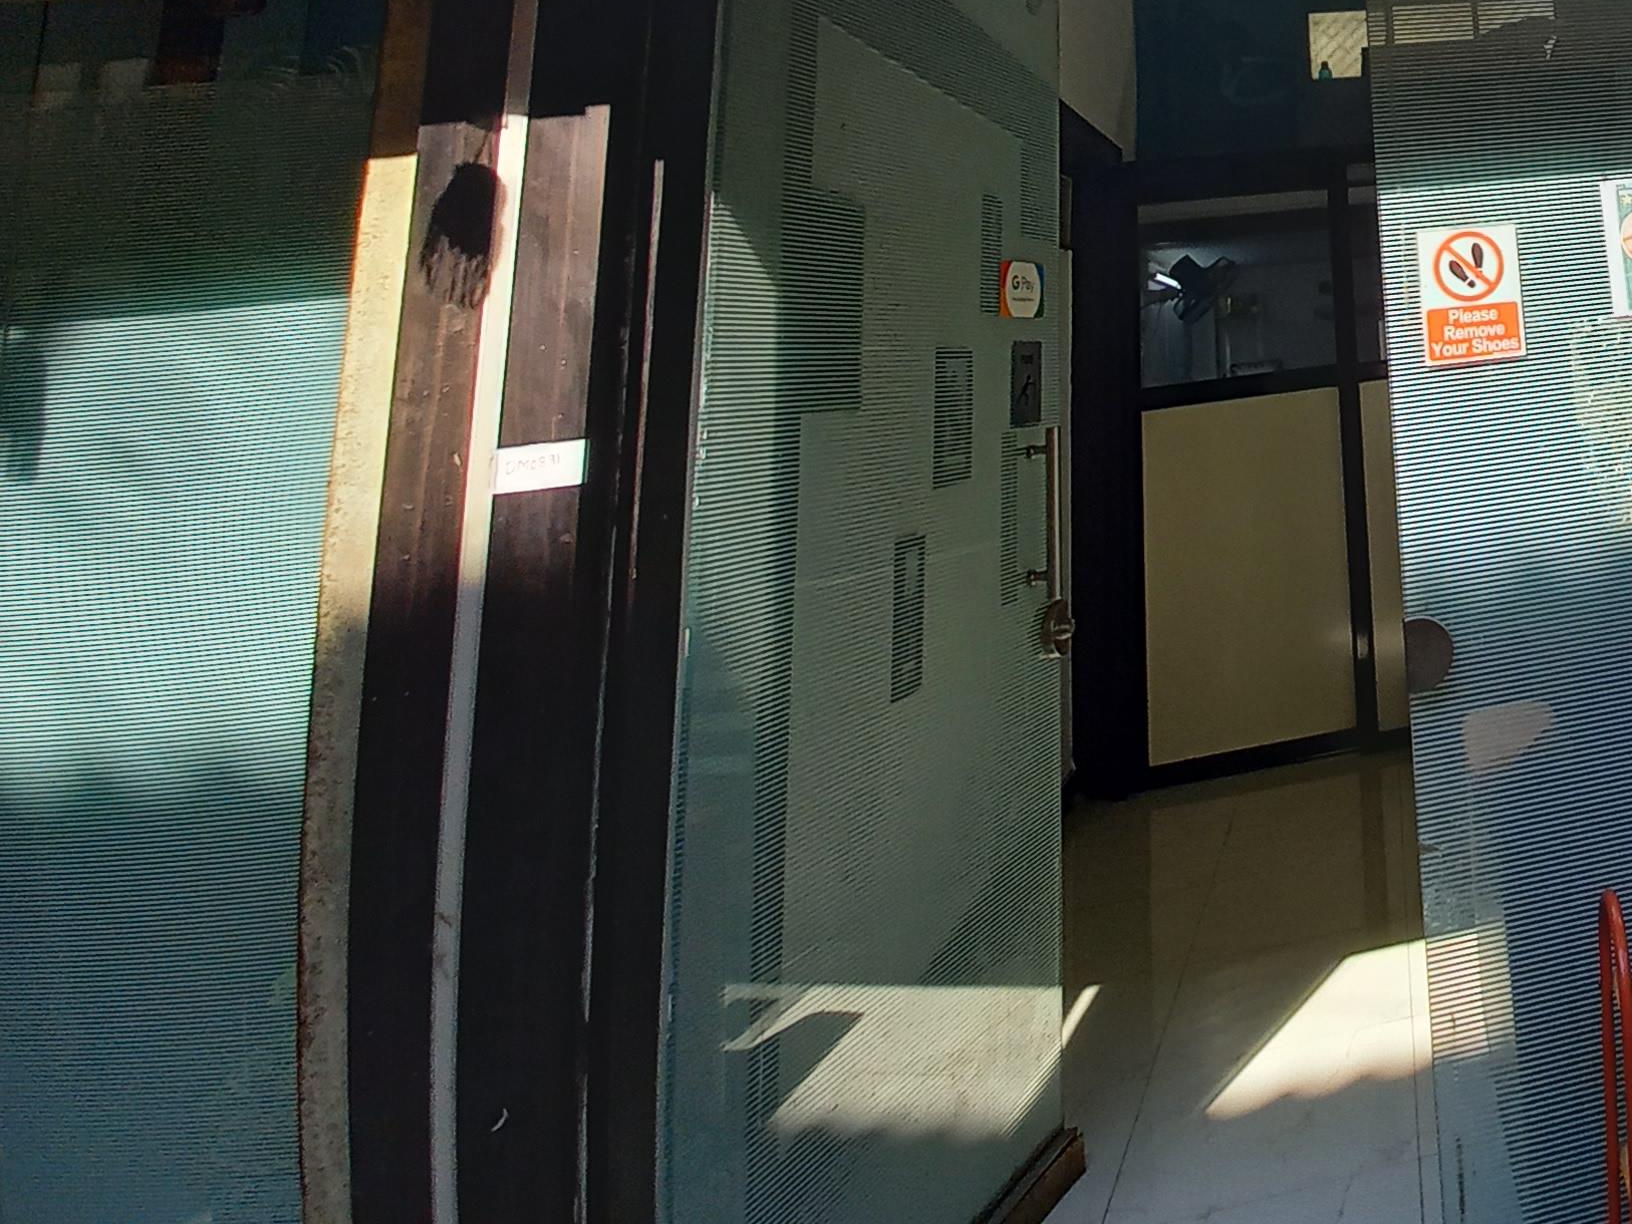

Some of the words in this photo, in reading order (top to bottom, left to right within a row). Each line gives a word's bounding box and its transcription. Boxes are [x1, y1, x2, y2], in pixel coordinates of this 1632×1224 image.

[1448, 309, 1498, 323] Please
[1443, 324, 1505, 340] Remove
[1431, 342, 1469, 357] Your
[1471, 337, 1520, 353] Shoes
